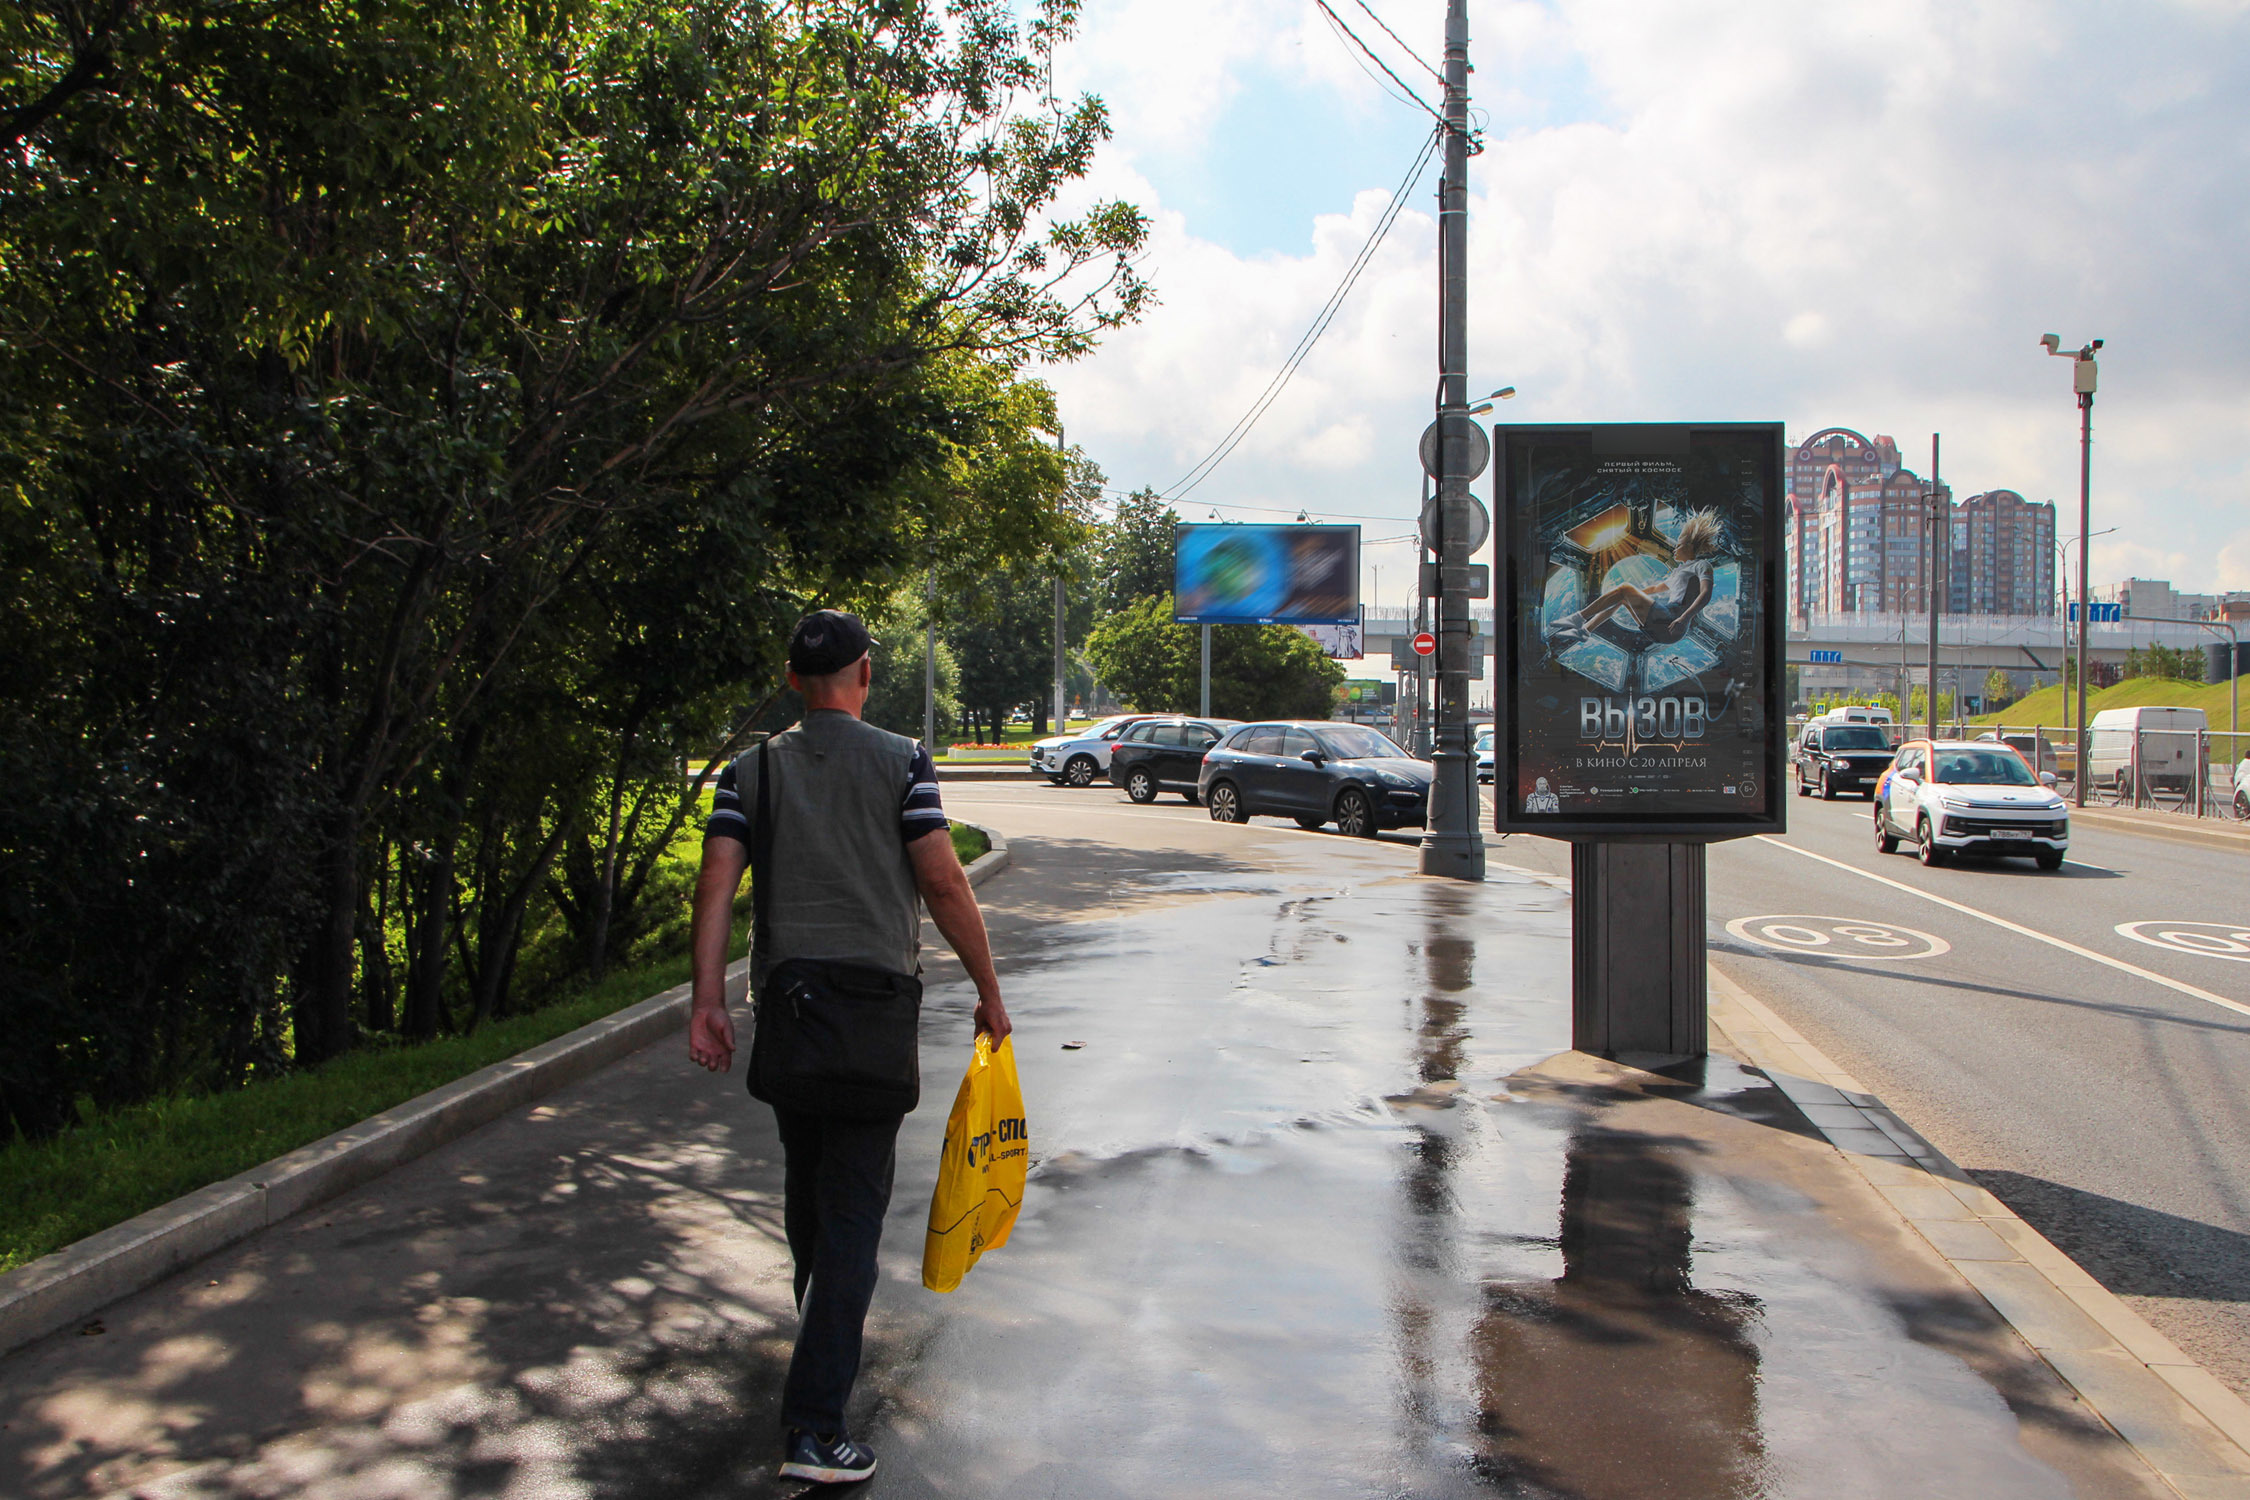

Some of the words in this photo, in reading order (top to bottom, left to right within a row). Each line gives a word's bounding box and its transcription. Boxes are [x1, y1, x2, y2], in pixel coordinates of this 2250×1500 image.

[1580, 696, 1705, 738] ВЫЗОВ
[1576, 757, 1583, 767] В
[1587, 757, 1626, 767] КИНО
[1629, 757, 1639, 767] С
[1641, 757, 1655, 767] 20
[1658, 757, 1707, 767] АПРЕЛЯ
